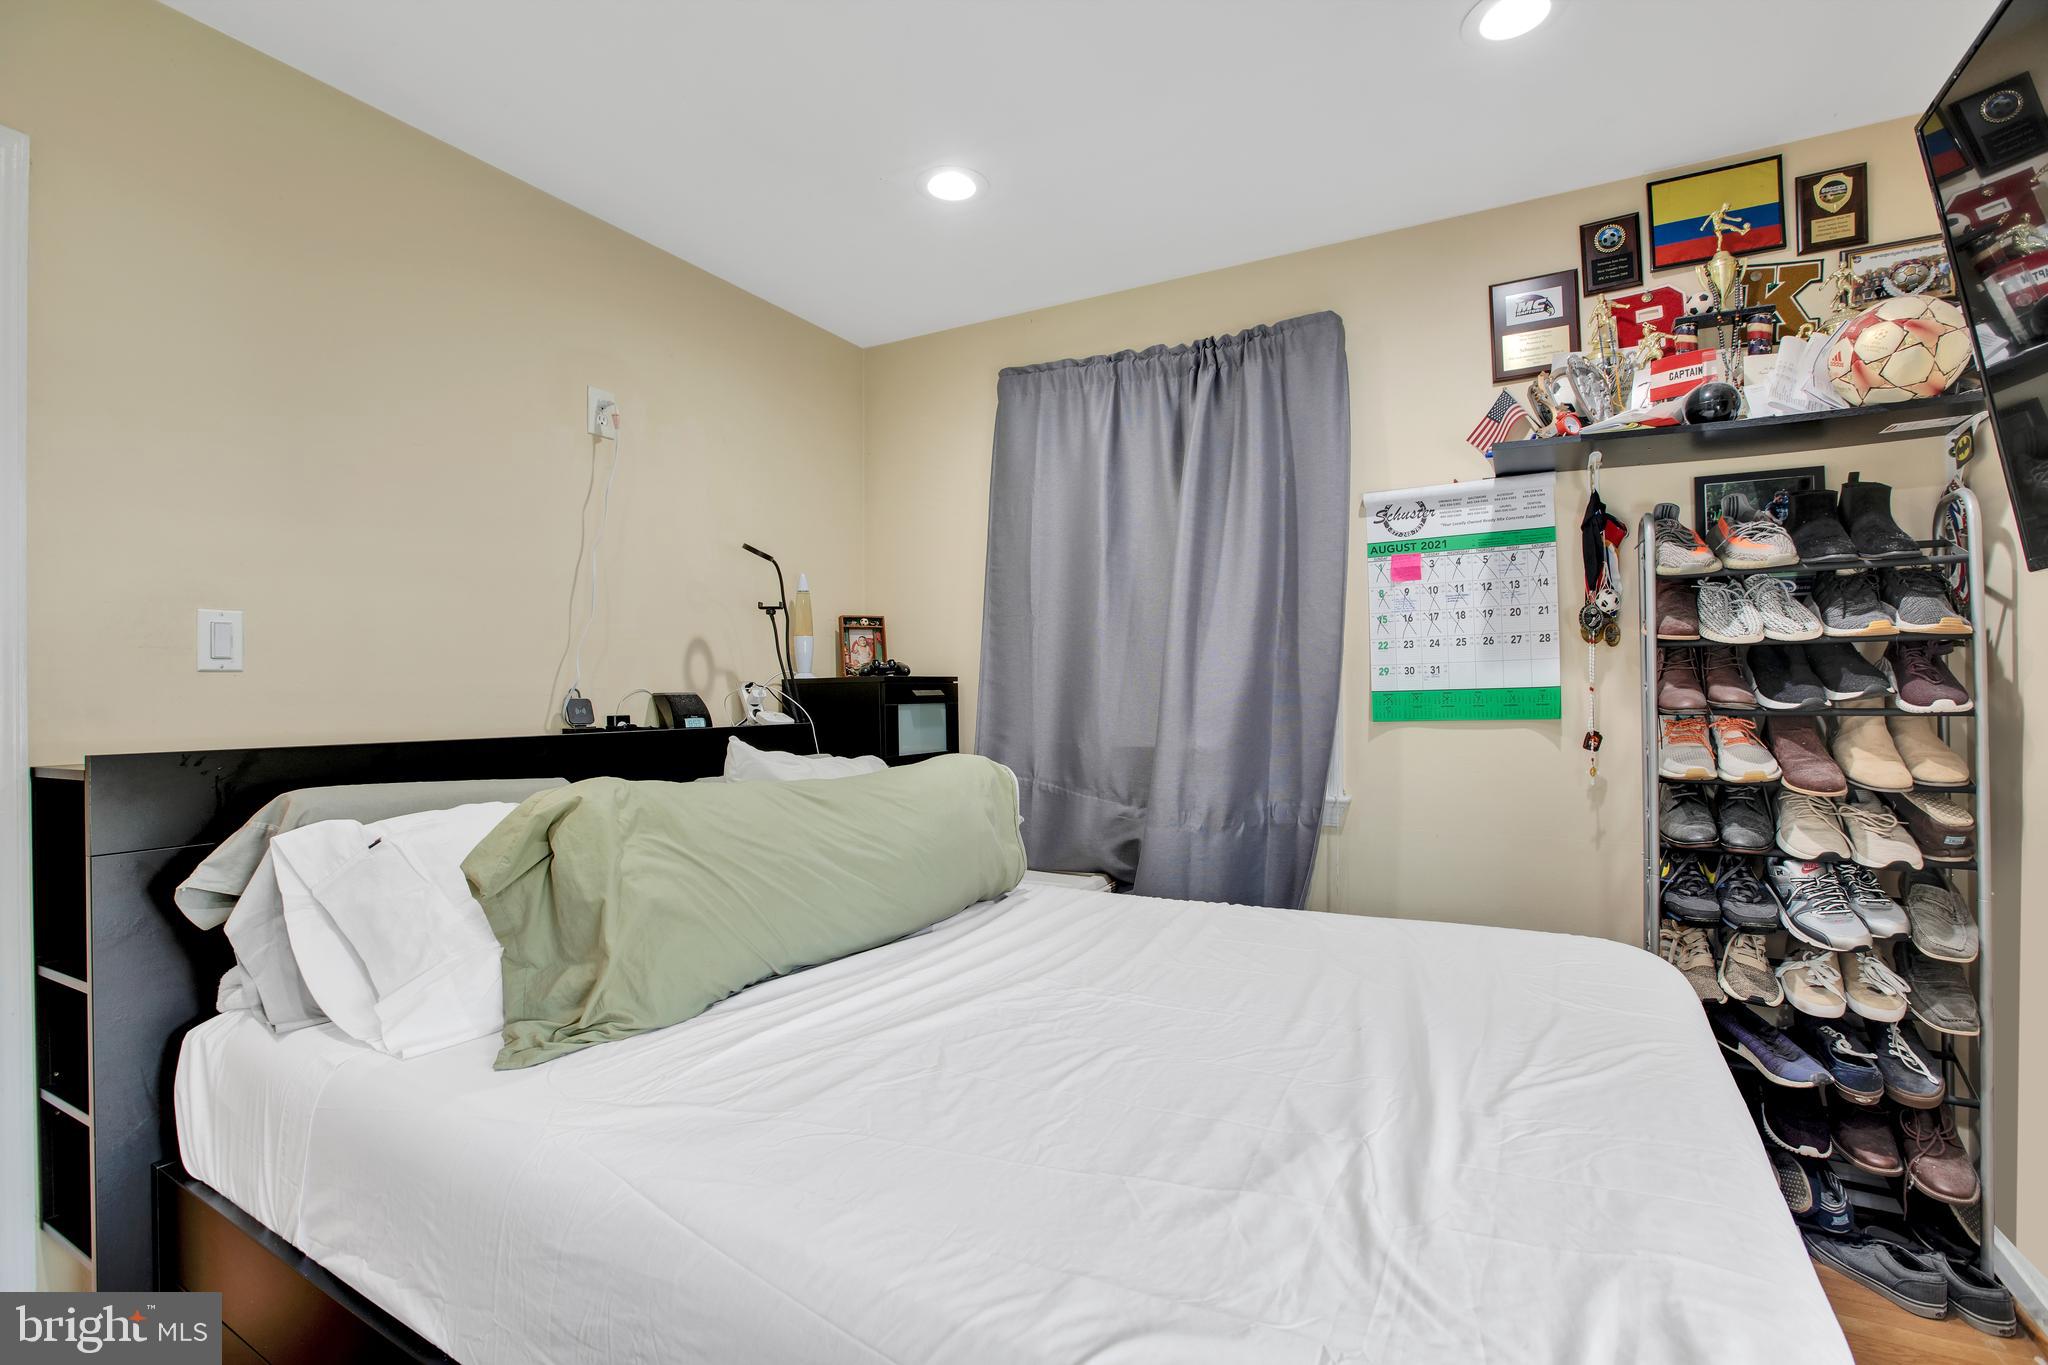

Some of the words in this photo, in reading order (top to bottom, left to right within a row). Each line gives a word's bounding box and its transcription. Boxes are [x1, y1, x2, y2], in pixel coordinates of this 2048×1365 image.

[1668, 366, 1704, 381] CAPTAIN
[1373, 506, 1436, 524] Schuster
[1370, 542, 1417, 555] AUGUST
[1421, 539, 1447, 551] 2021
[1428, 560, 1436, 568] 3
[1455, 557, 1462, 565] 4
[1482, 555, 1489, 564] 5
[1510, 553, 1517, 562] 6
[1538, 550, 1545, 559] 7
[1377, 589, 1385, 598] 8
[1404, 587, 1410, 596] 9
[1427, 585, 1439, 595] 10
[1454, 583, 1466, 593] 11
[1481, 582, 1493, 591] 12
[1509, 580, 1521, 589] 13
[1537, 577, 1549, 587] 14
[1376, 614, 1389, 624] 15
[1402, 614, 1413, 622] 16
[1428, 612, 1440, 621] 17
[1455, 610, 1466, 620] 18
[1482, 609, 1494, 618] 19
[1509, 607, 1522, 617] 20
[1538, 605, 1549, 615] 21
[1378, 640, 1389, 650] 22
[1403, 640, 1415, 649] 23
[1429, 638, 1440, 648] 24
[1455, 637, 1467, 646] 25
[1482, 636, 1495, 646] 26
[1510, 635, 1522, 645] 27
[1539, 633, 1551, 643] 28
[1378, 667, 1390, 676] 29
[1404, 666, 1415, 675] 30
[1430, 665, 1440, 675] 31
